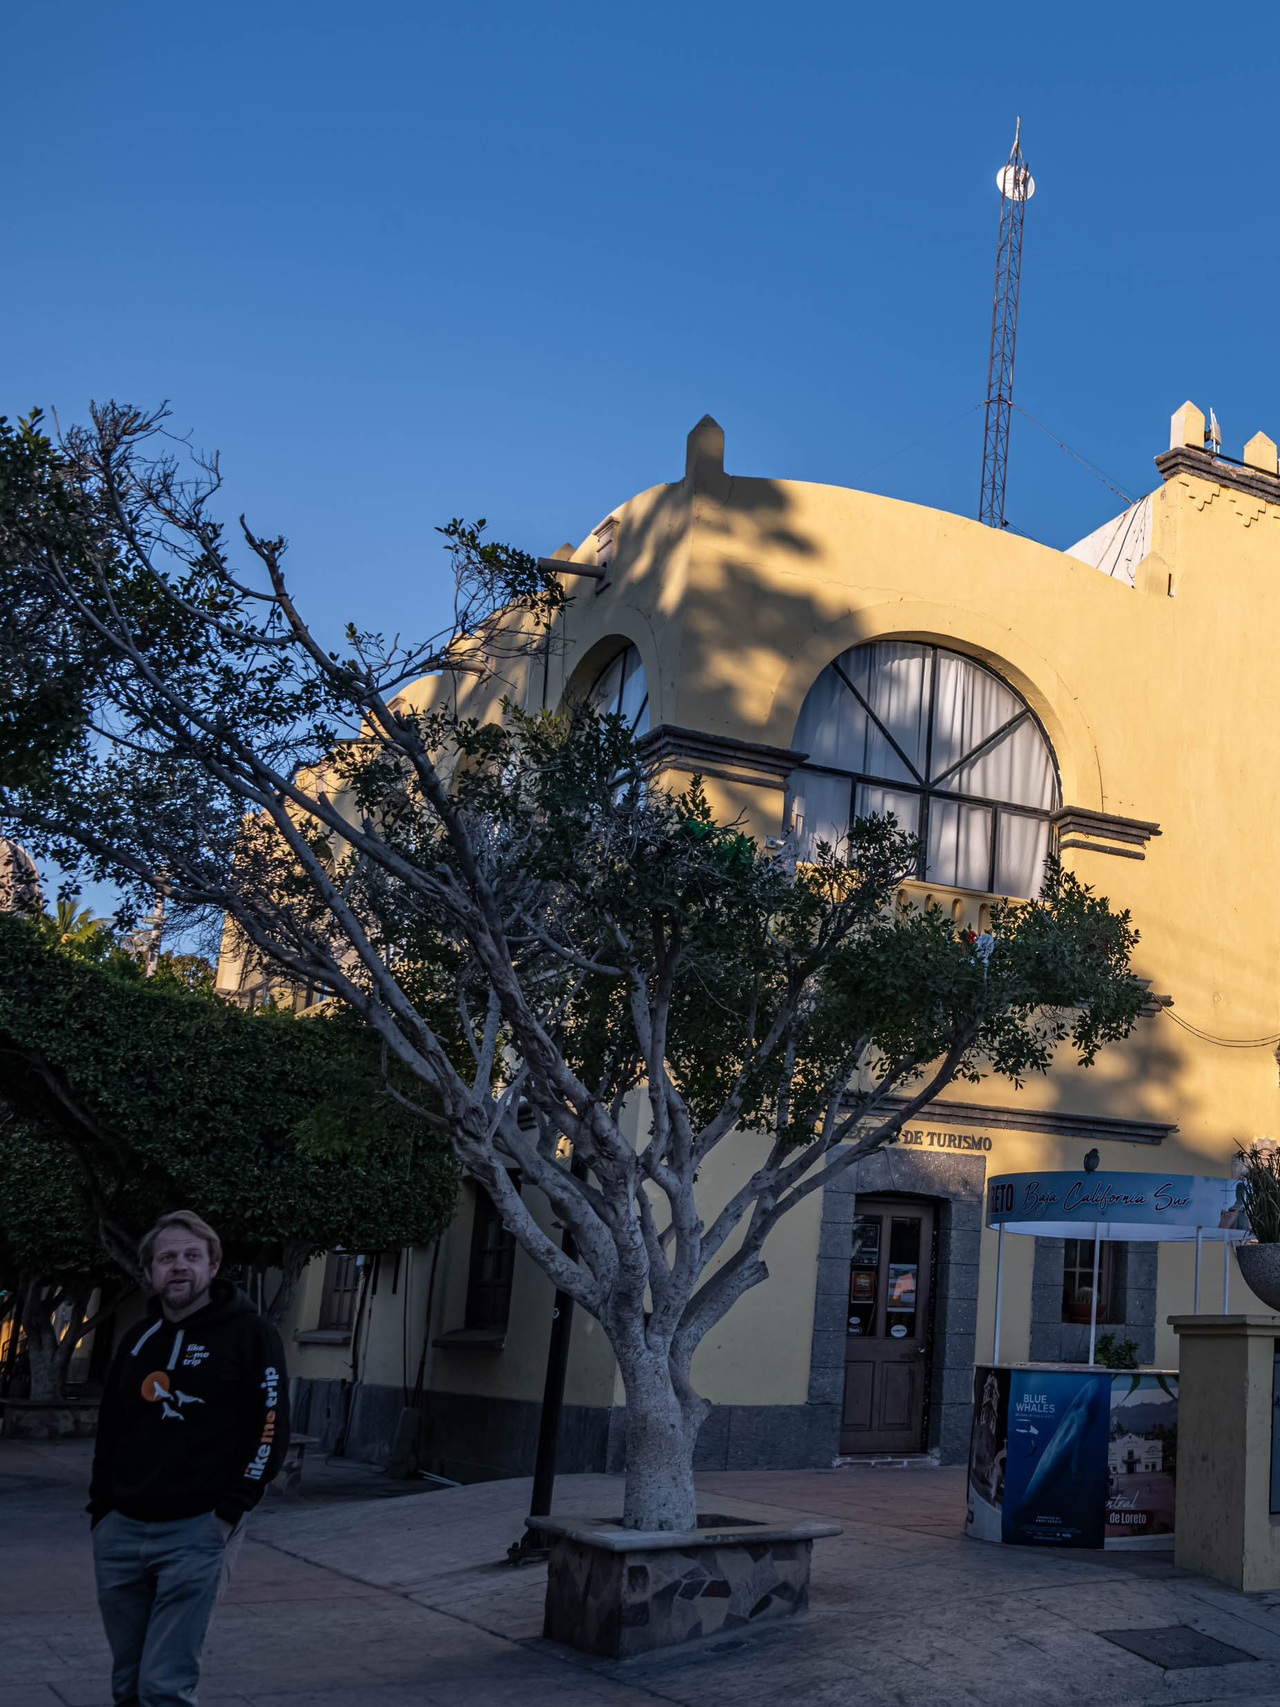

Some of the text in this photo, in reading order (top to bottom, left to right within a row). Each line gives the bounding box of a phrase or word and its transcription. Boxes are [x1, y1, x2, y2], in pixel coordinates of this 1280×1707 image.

[903, 1131, 923, 1145] DE
[926, 1132, 992, 1151] TURISMO
[990, 1181, 1190, 1216] RETO Baja California Sur
[187, 1343, 205, 1352] like
[183, 1358, 202, 1367] trip
[261, 1366, 280, 1408] trip
[1023, 1394, 1048, 1404] BLUE
[1015, 1402, 1056, 1414] WHALES
[1106, 1491, 1139, 1509] ntral
[1109, 1512, 1147, 1524] de Loreto
